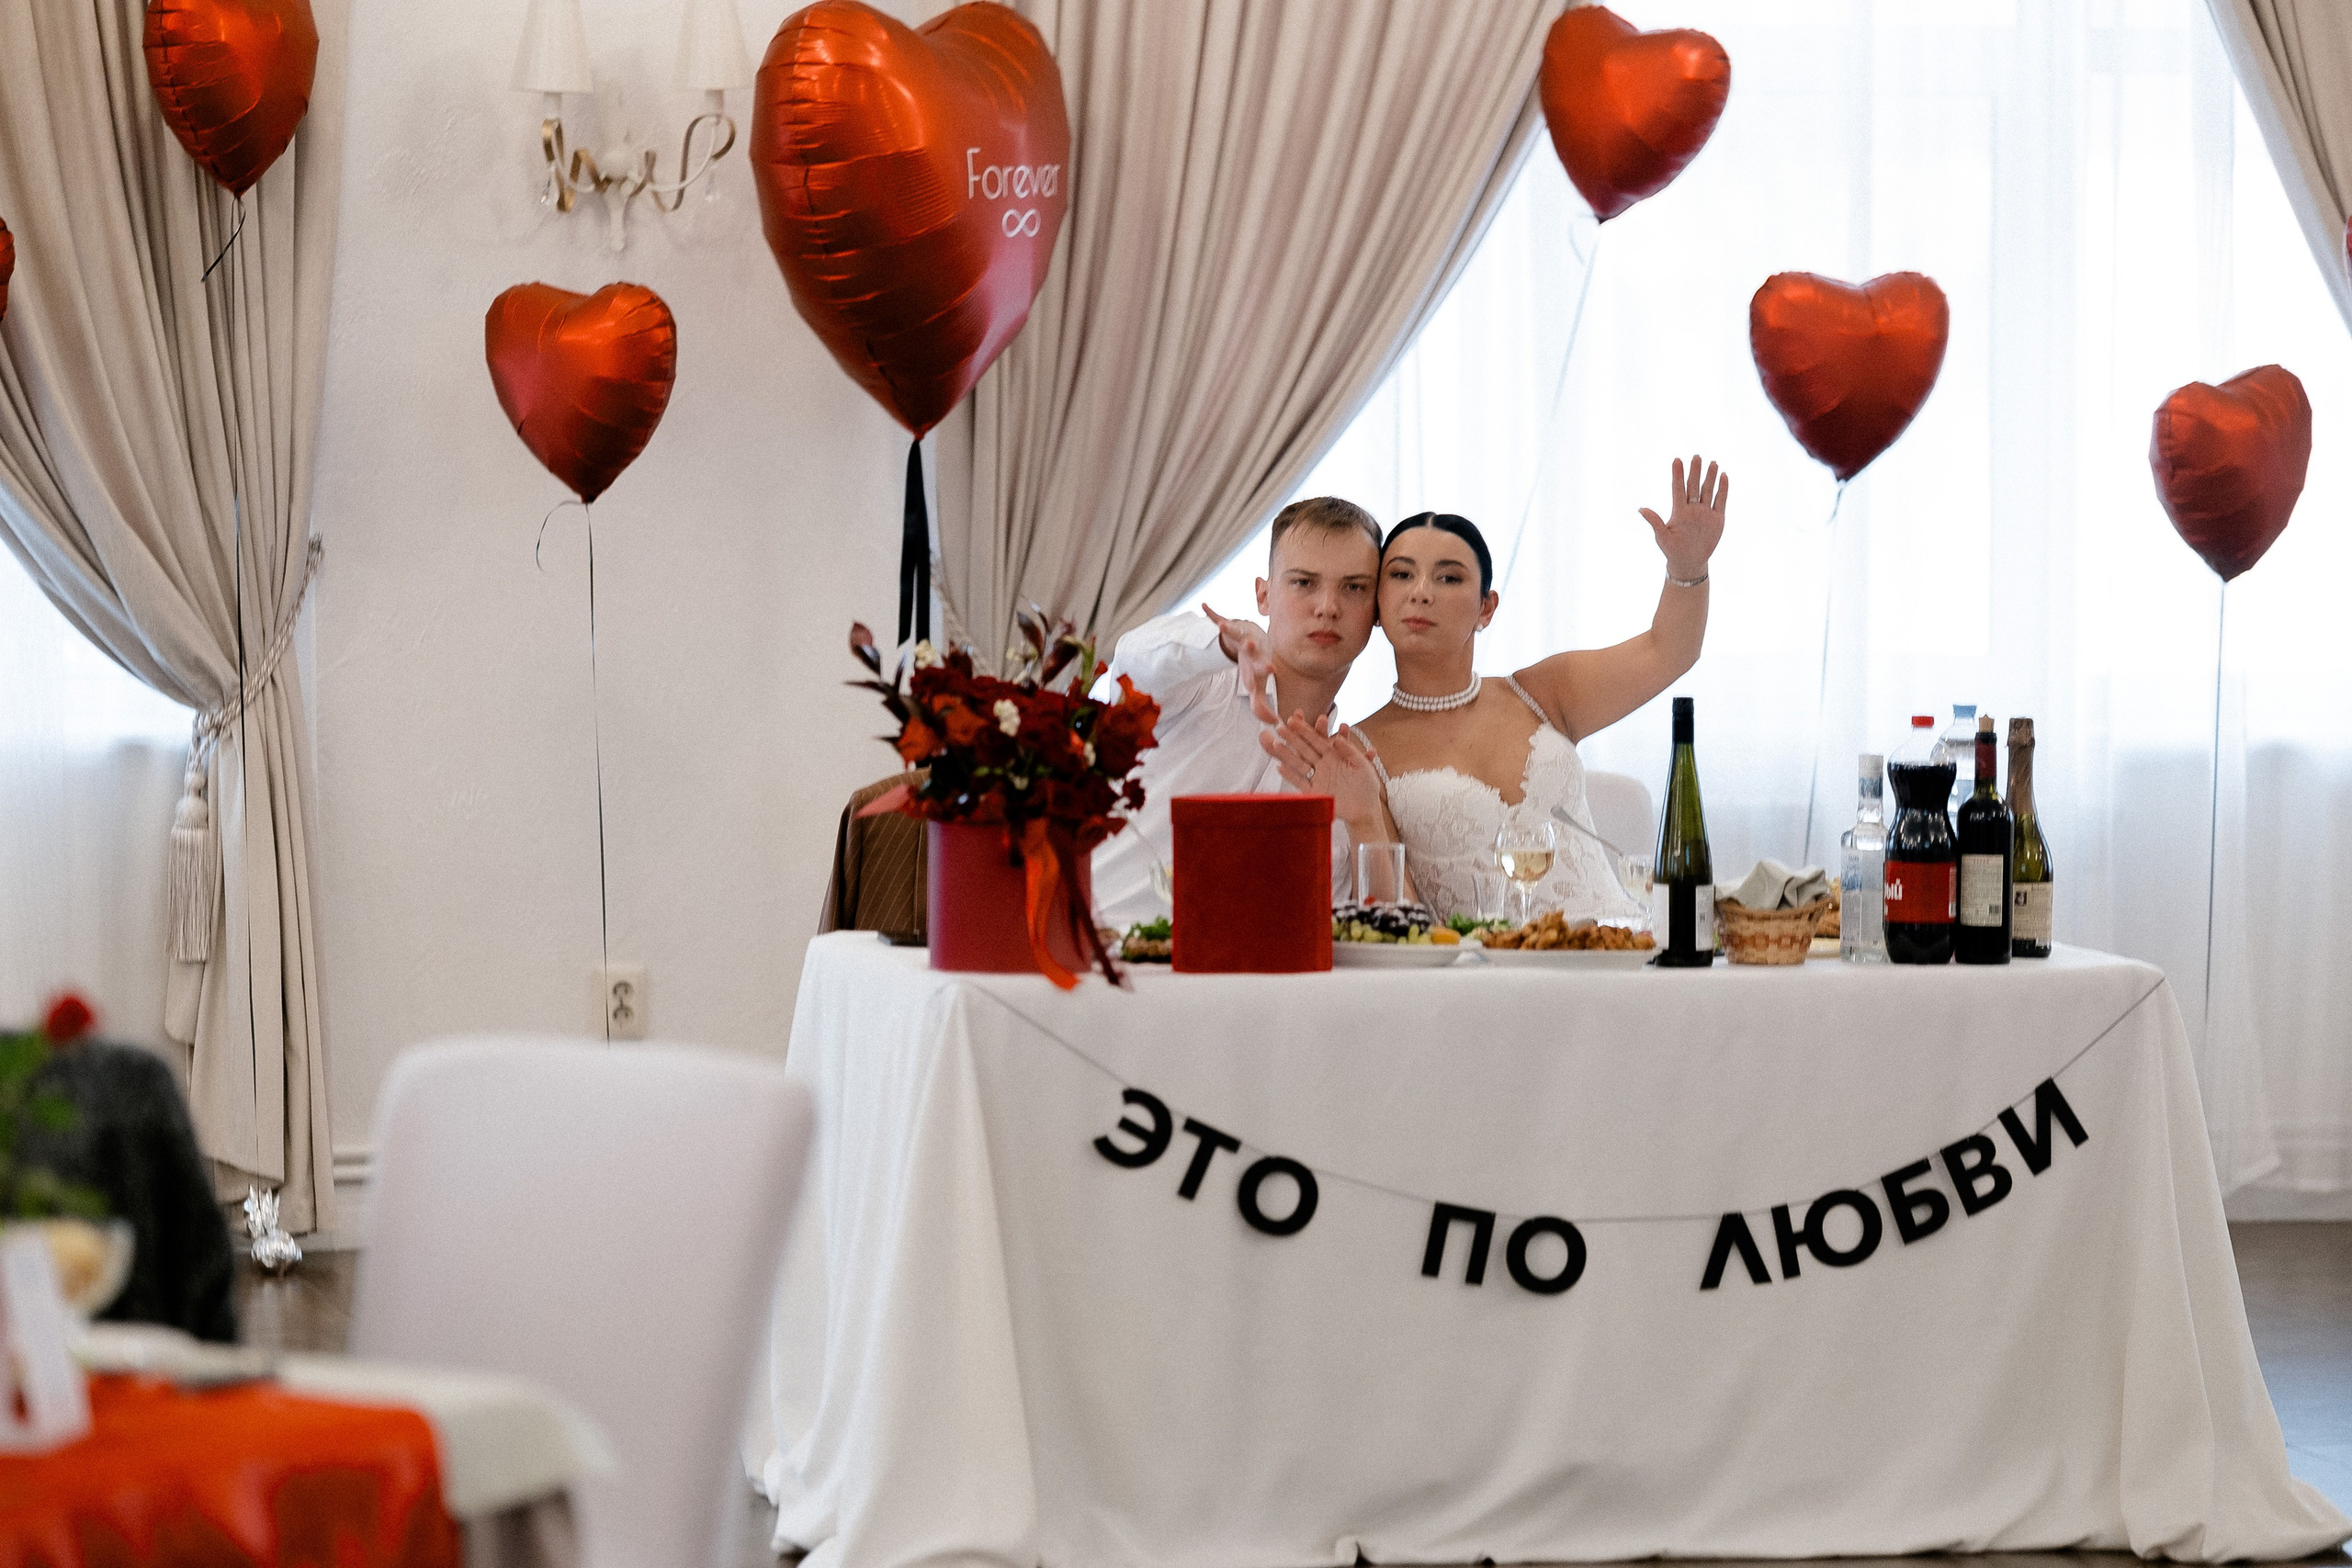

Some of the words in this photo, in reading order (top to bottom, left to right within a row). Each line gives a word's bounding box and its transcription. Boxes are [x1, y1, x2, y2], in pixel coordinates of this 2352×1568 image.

[967, 147, 1061, 199] Forever
[1093, 1088, 1318, 1237] ЭТО
[1421, 1201, 1587, 1295] ПО
[1700, 1077, 2089, 1292] ЛЮБВИ
